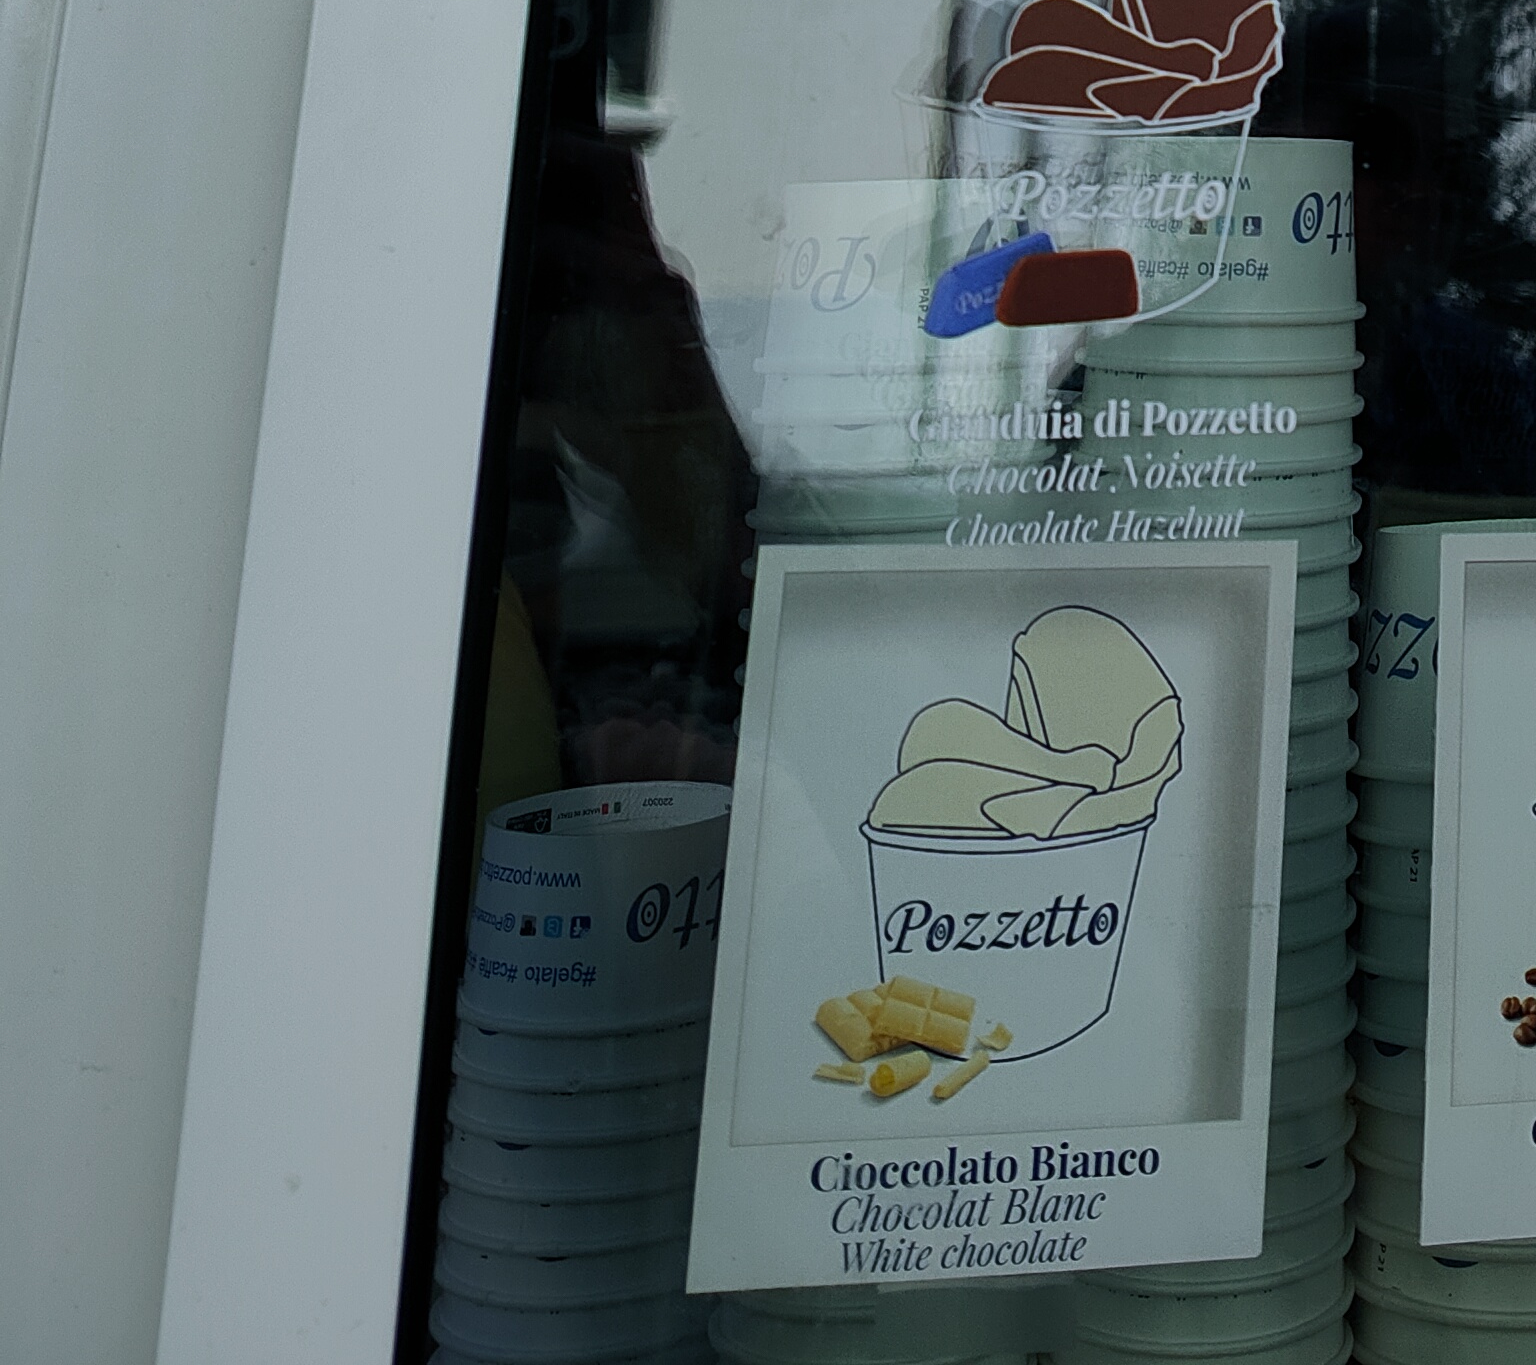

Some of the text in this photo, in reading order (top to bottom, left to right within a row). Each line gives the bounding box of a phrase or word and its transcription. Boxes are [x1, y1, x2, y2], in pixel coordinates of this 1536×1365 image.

[998, 168, 1228, 222] Pozzetto
[1093, 397, 1132, 438] di
[1142, 399, 1298, 437] Pozzetto
[946, 450, 1257, 497] Chocolat Noisette
[944, 504, 1247, 547] Chocolate Hazelnut
[884, 893, 1120, 956] Pozzetto
[524, 962, 598, 988] #gelato
[809, 1141, 1162, 1194] Cioccolato Bianco
[829, 1185, 1107, 1237] Chocolat Blanc
[839, 1231, 1088, 1278] White chocolate
